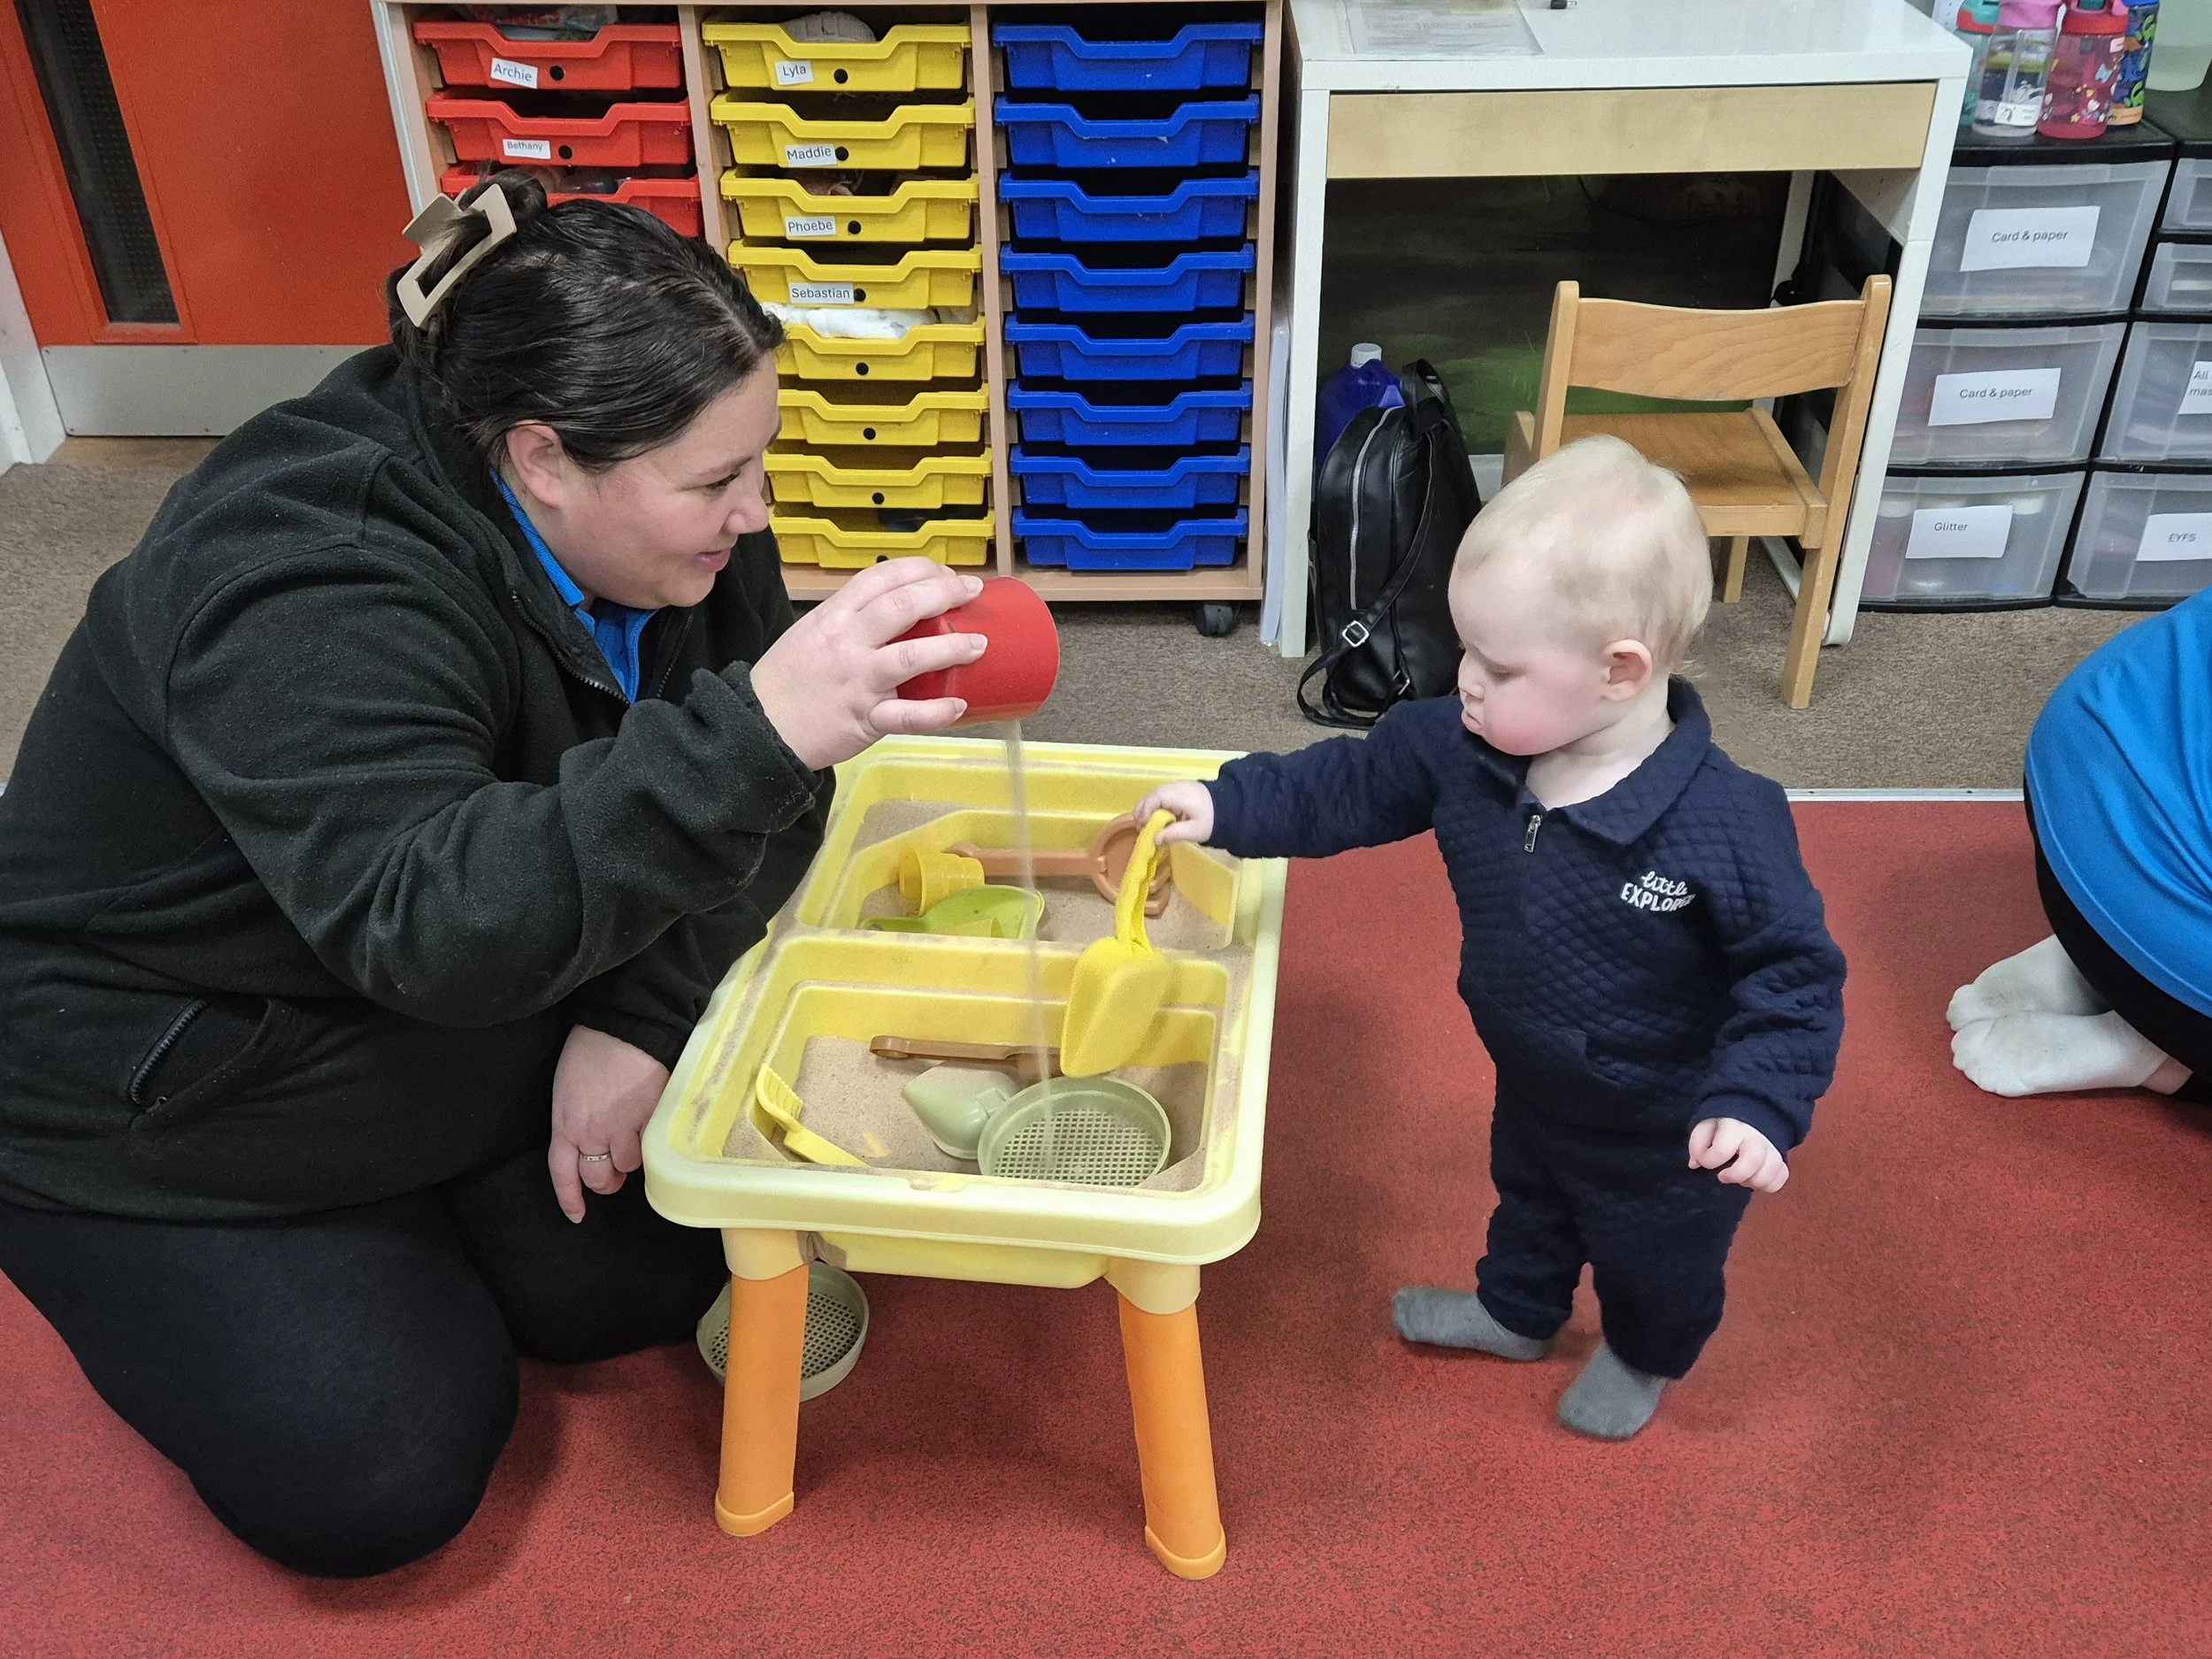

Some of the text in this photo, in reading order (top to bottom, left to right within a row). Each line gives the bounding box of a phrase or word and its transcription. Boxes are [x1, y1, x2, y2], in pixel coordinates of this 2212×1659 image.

[493, 63, 533, 82] Archie
[782, 64, 807, 78] Lyla
[506, 141, 543, 152] Bethany
[787, 146, 832, 160] Maddie
[787, 220, 833, 232] Phoebe
[1992, 230, 2069, 243] Card & paper
[791, 288, 850, 298] Sebastian
[2193, 370, 2209, 380] All
[1959, 388, 2033, 399] Card & paper
[1933, 522, 1969, 532] Glitter
[2169, 533, 2196, 542] EYFS
